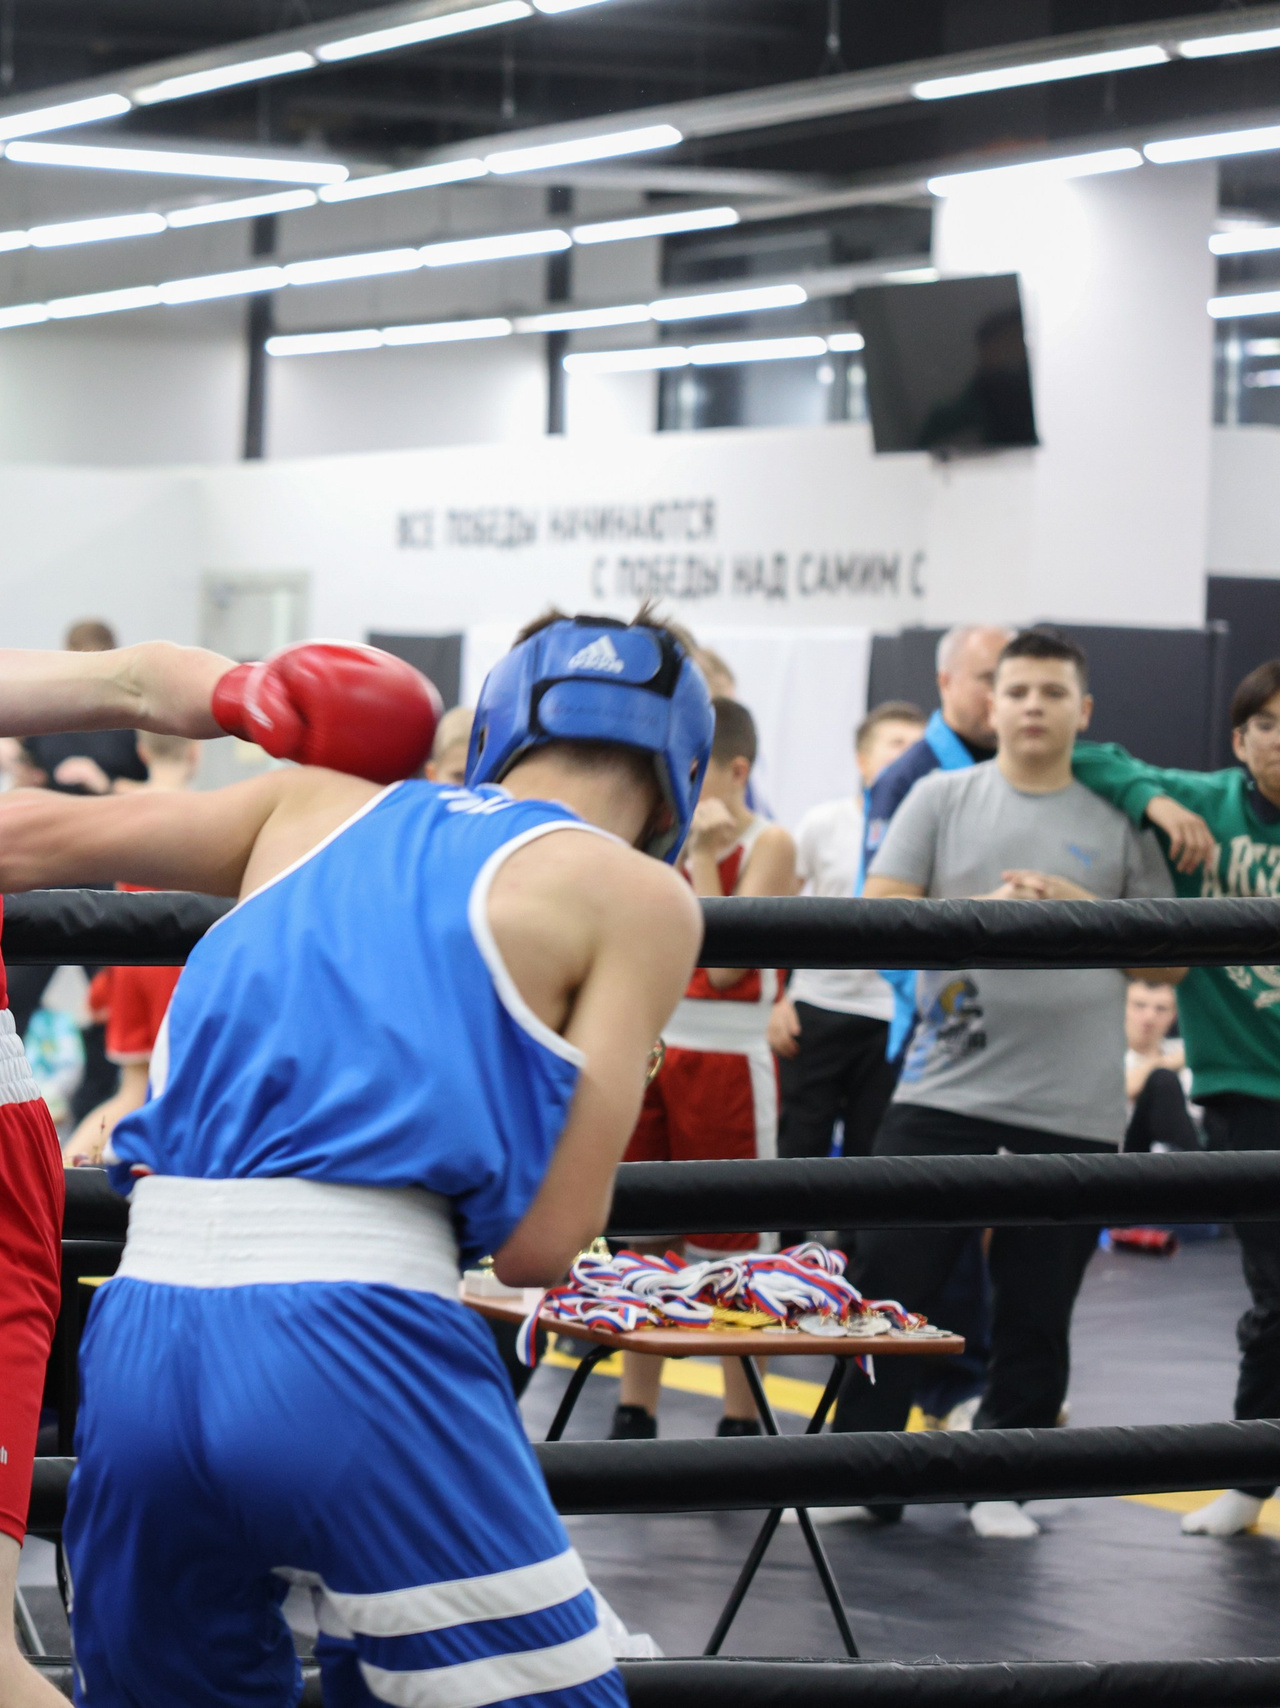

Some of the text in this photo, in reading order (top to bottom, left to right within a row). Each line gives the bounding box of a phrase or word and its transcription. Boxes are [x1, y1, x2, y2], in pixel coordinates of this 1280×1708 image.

[397, 497, 717, 551] ВСЕ ПОБЕДЫ НАЧИНАЮТСЯ
[617, 552, 721, 600] ПОБЕДЫ
[731, 551, 788, 600] НАД
[797, 551, 902, 599] САМИМ
